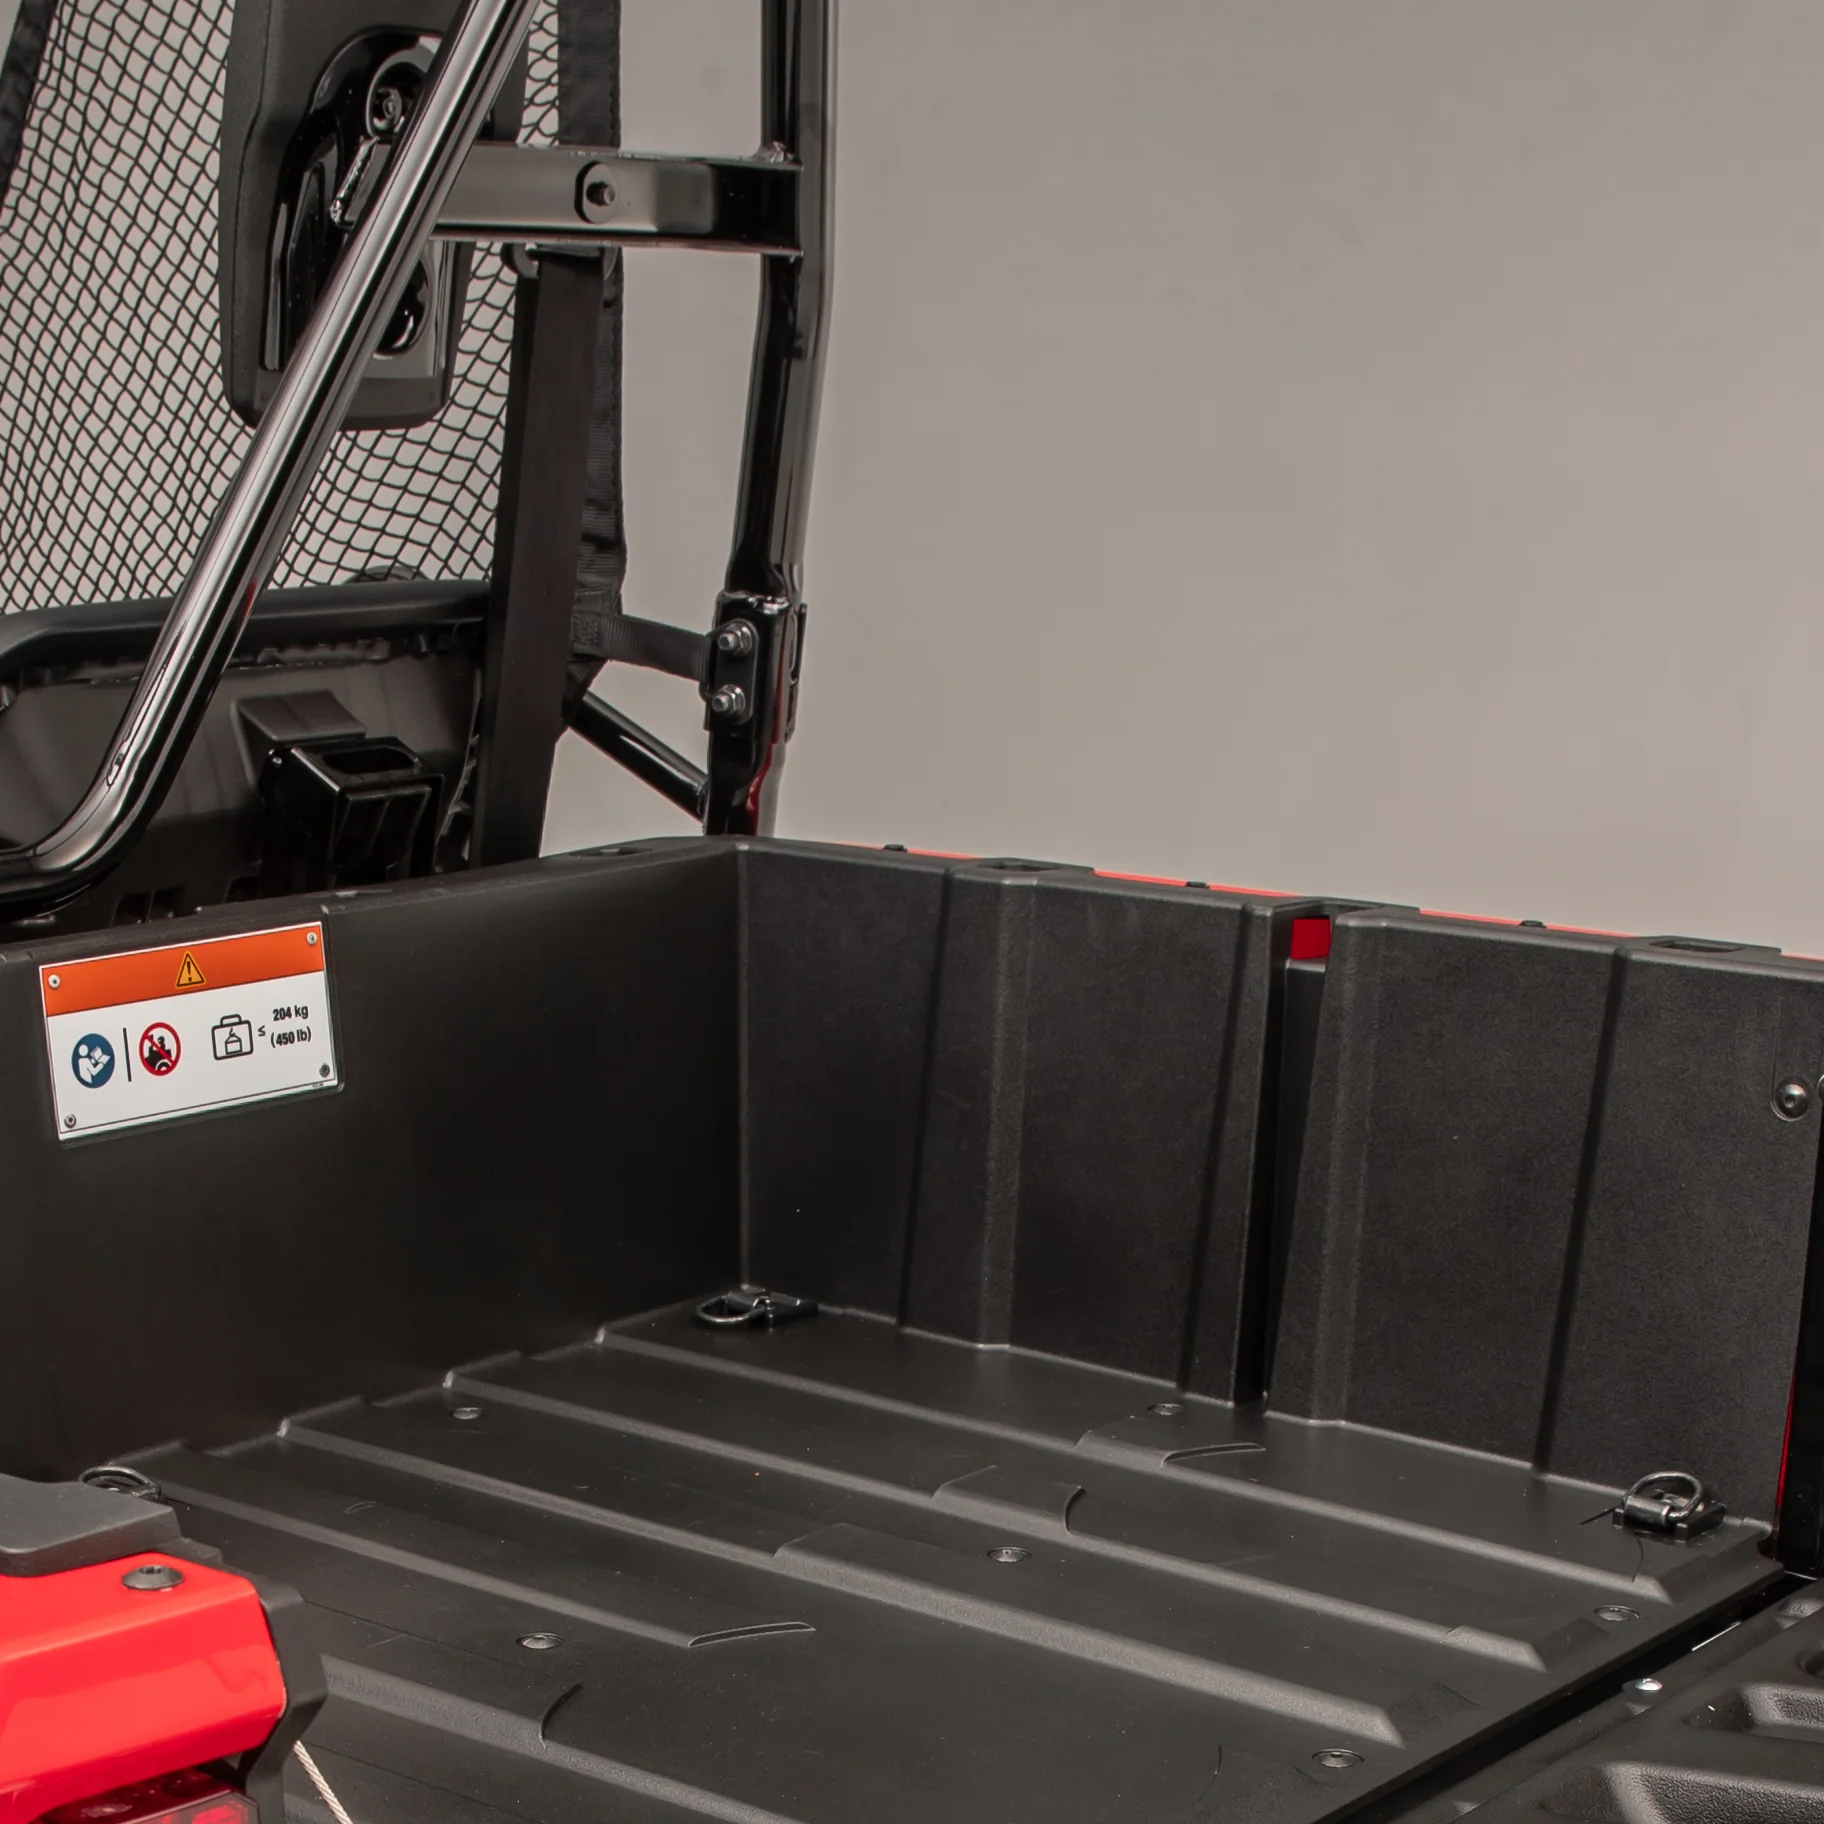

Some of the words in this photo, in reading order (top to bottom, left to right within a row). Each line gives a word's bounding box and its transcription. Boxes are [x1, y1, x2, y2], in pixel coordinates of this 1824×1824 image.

[273, 1006, 292, 1021] 204
[294, 1005, 308, 1019] kg
[271, 1032, 295, 1048] (450
[297, 1026, 312, 1042] lb)
